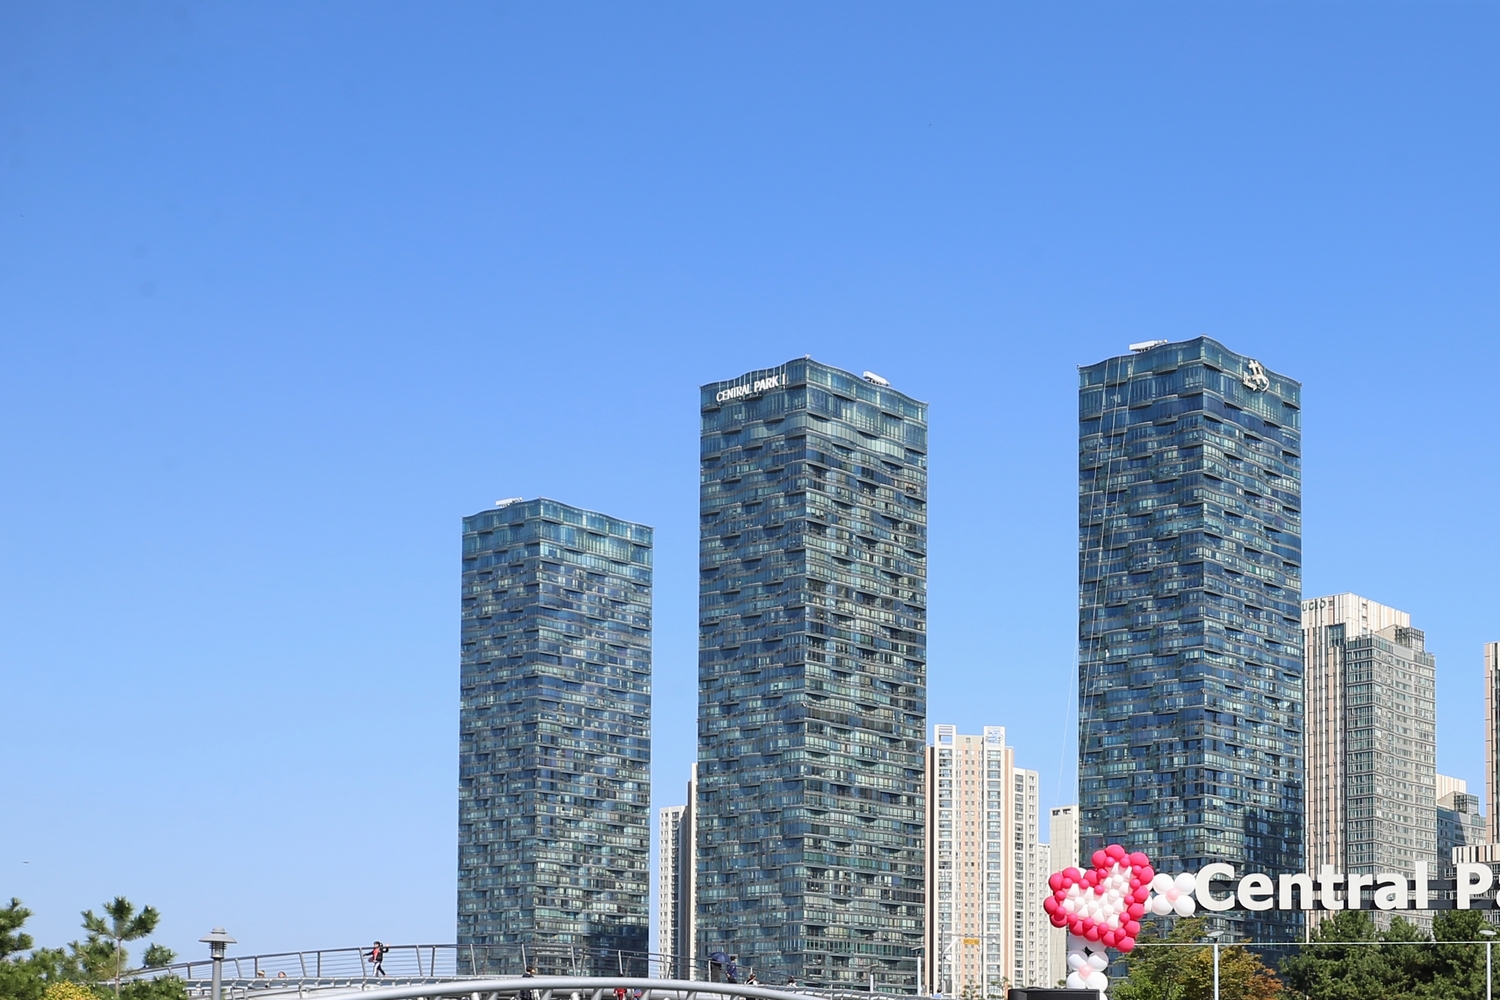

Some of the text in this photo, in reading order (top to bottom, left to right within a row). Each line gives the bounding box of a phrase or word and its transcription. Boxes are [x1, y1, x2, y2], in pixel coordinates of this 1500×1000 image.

[716, 383, 752, 401] CENTRAL
[754, 375, 779, 392] PARK
[1195, 861, 1428, 911] Central
